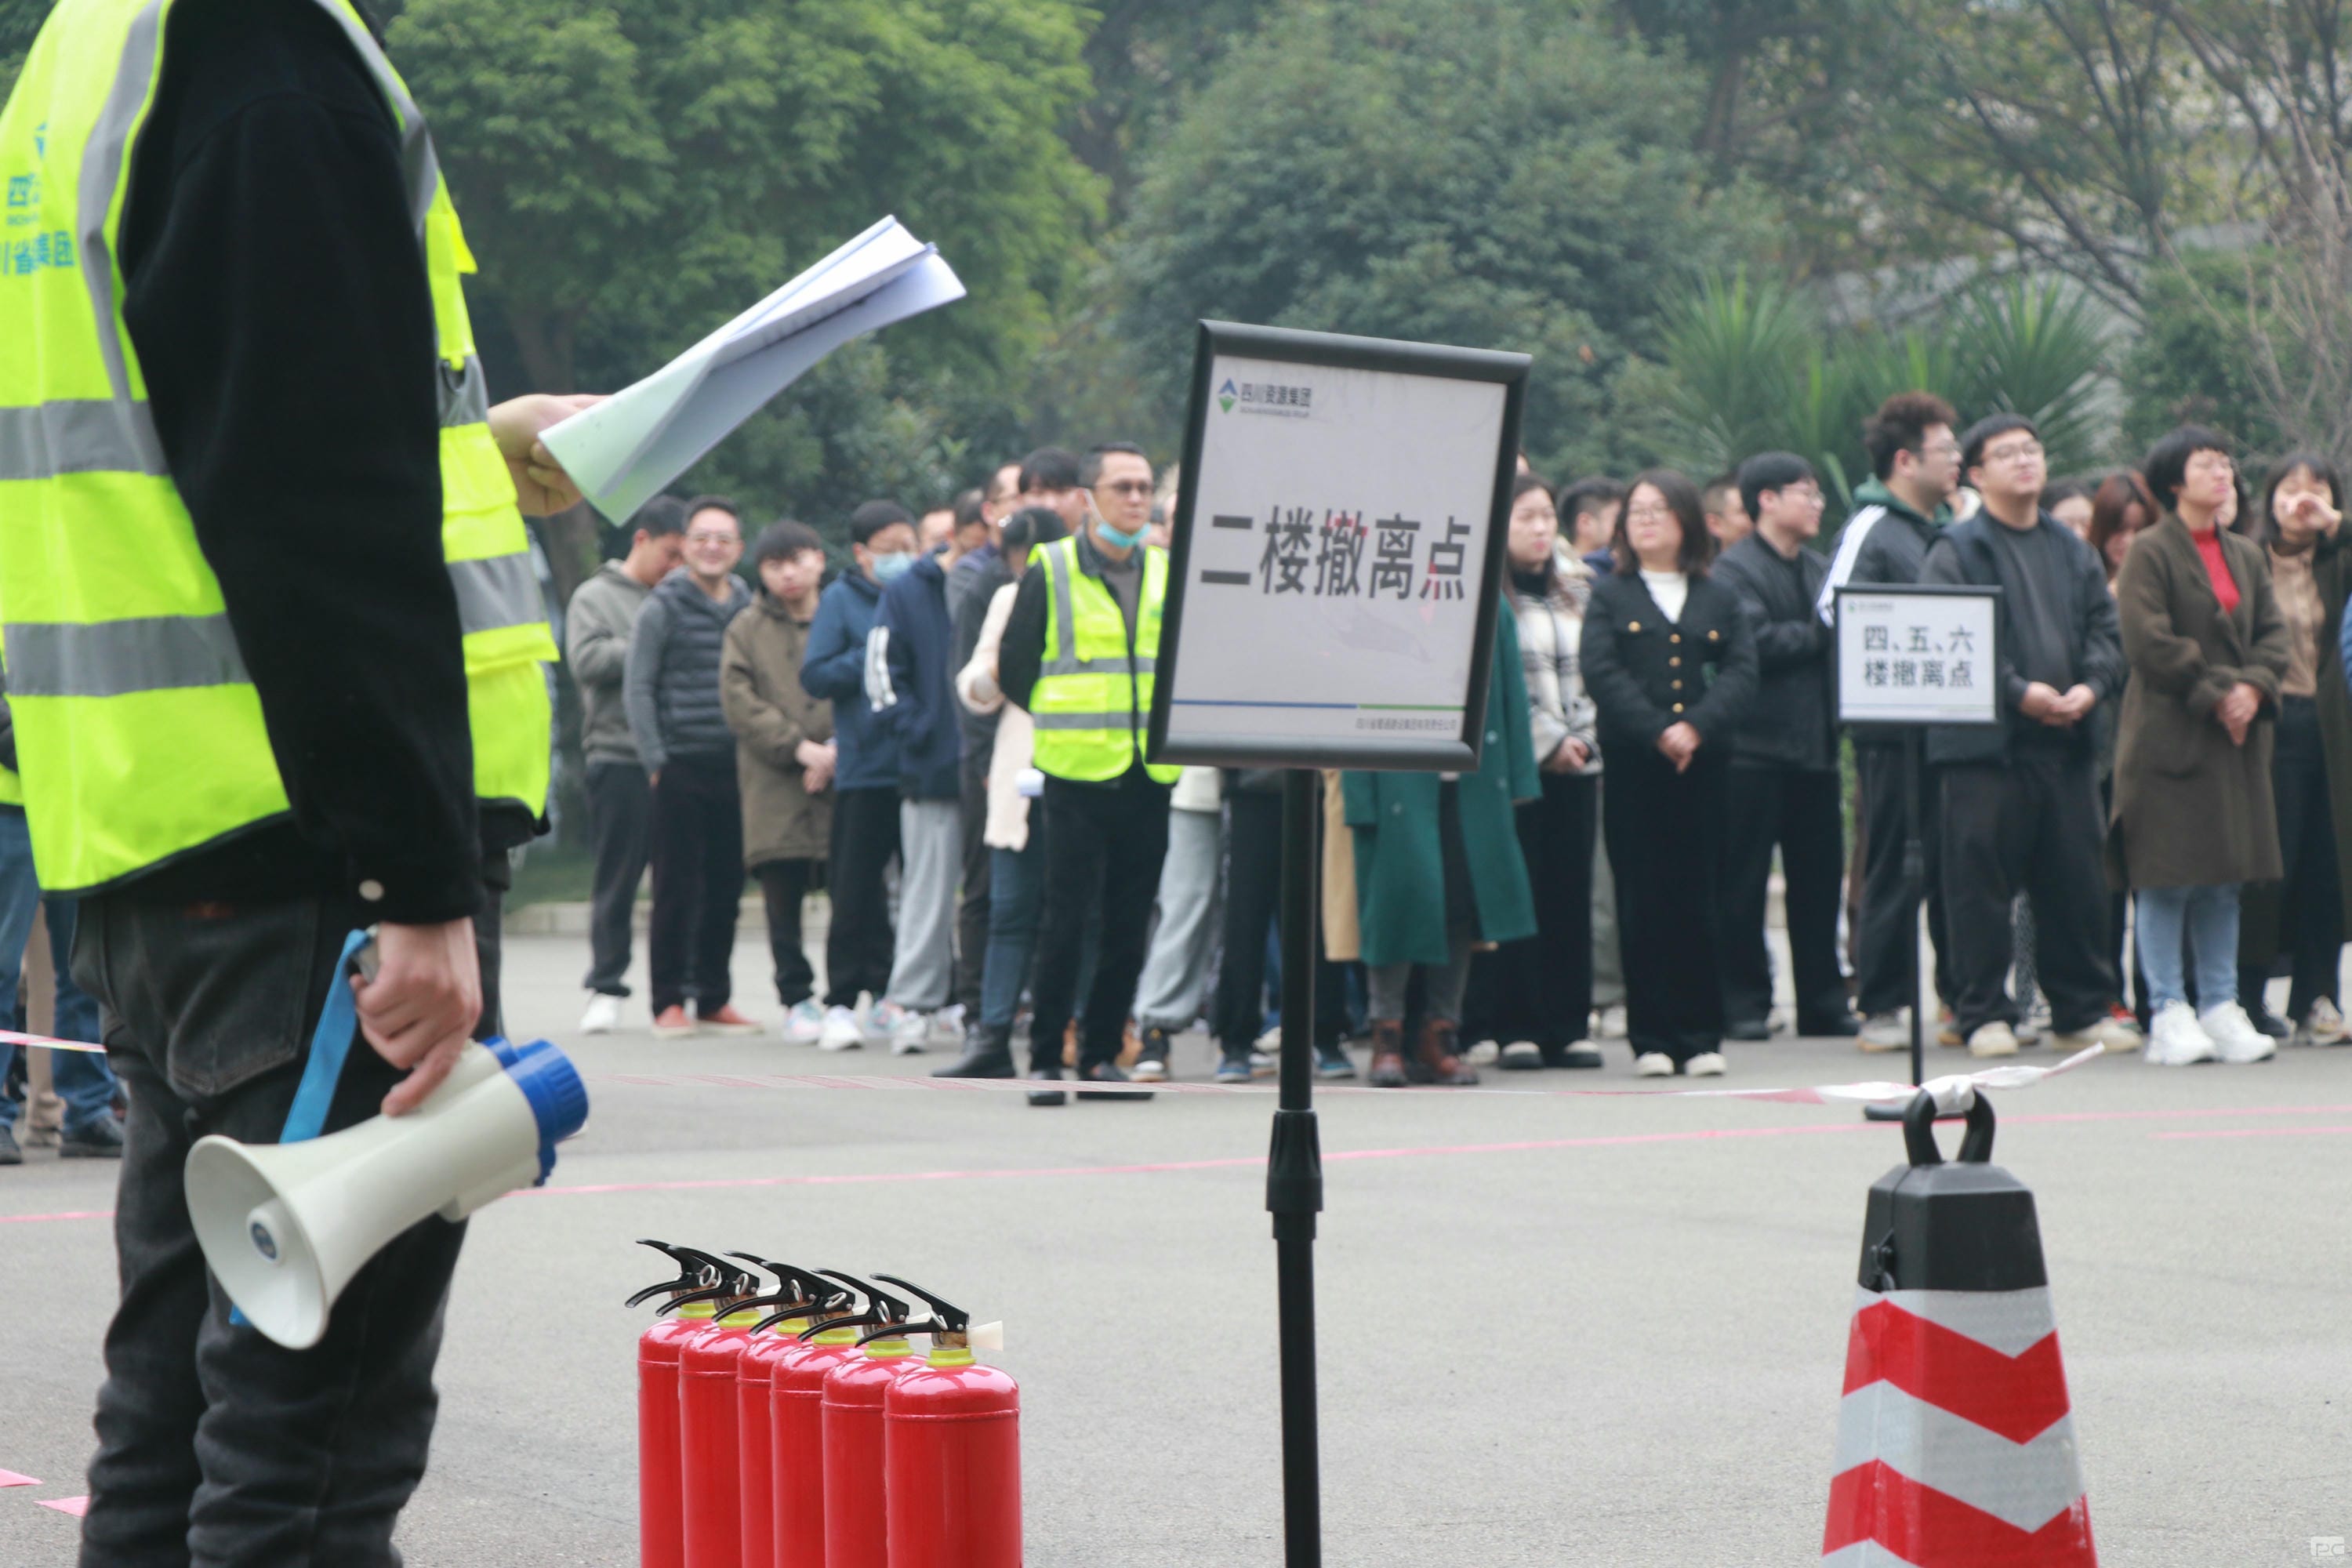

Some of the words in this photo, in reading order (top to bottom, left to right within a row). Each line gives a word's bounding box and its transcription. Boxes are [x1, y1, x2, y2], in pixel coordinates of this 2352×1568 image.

[1200, 505, 1471, 601] 二楼撤离点
[1864, 625, 1974, 652] 四、五、六
[1864, 659, 1973, 688] 楼撤离点
